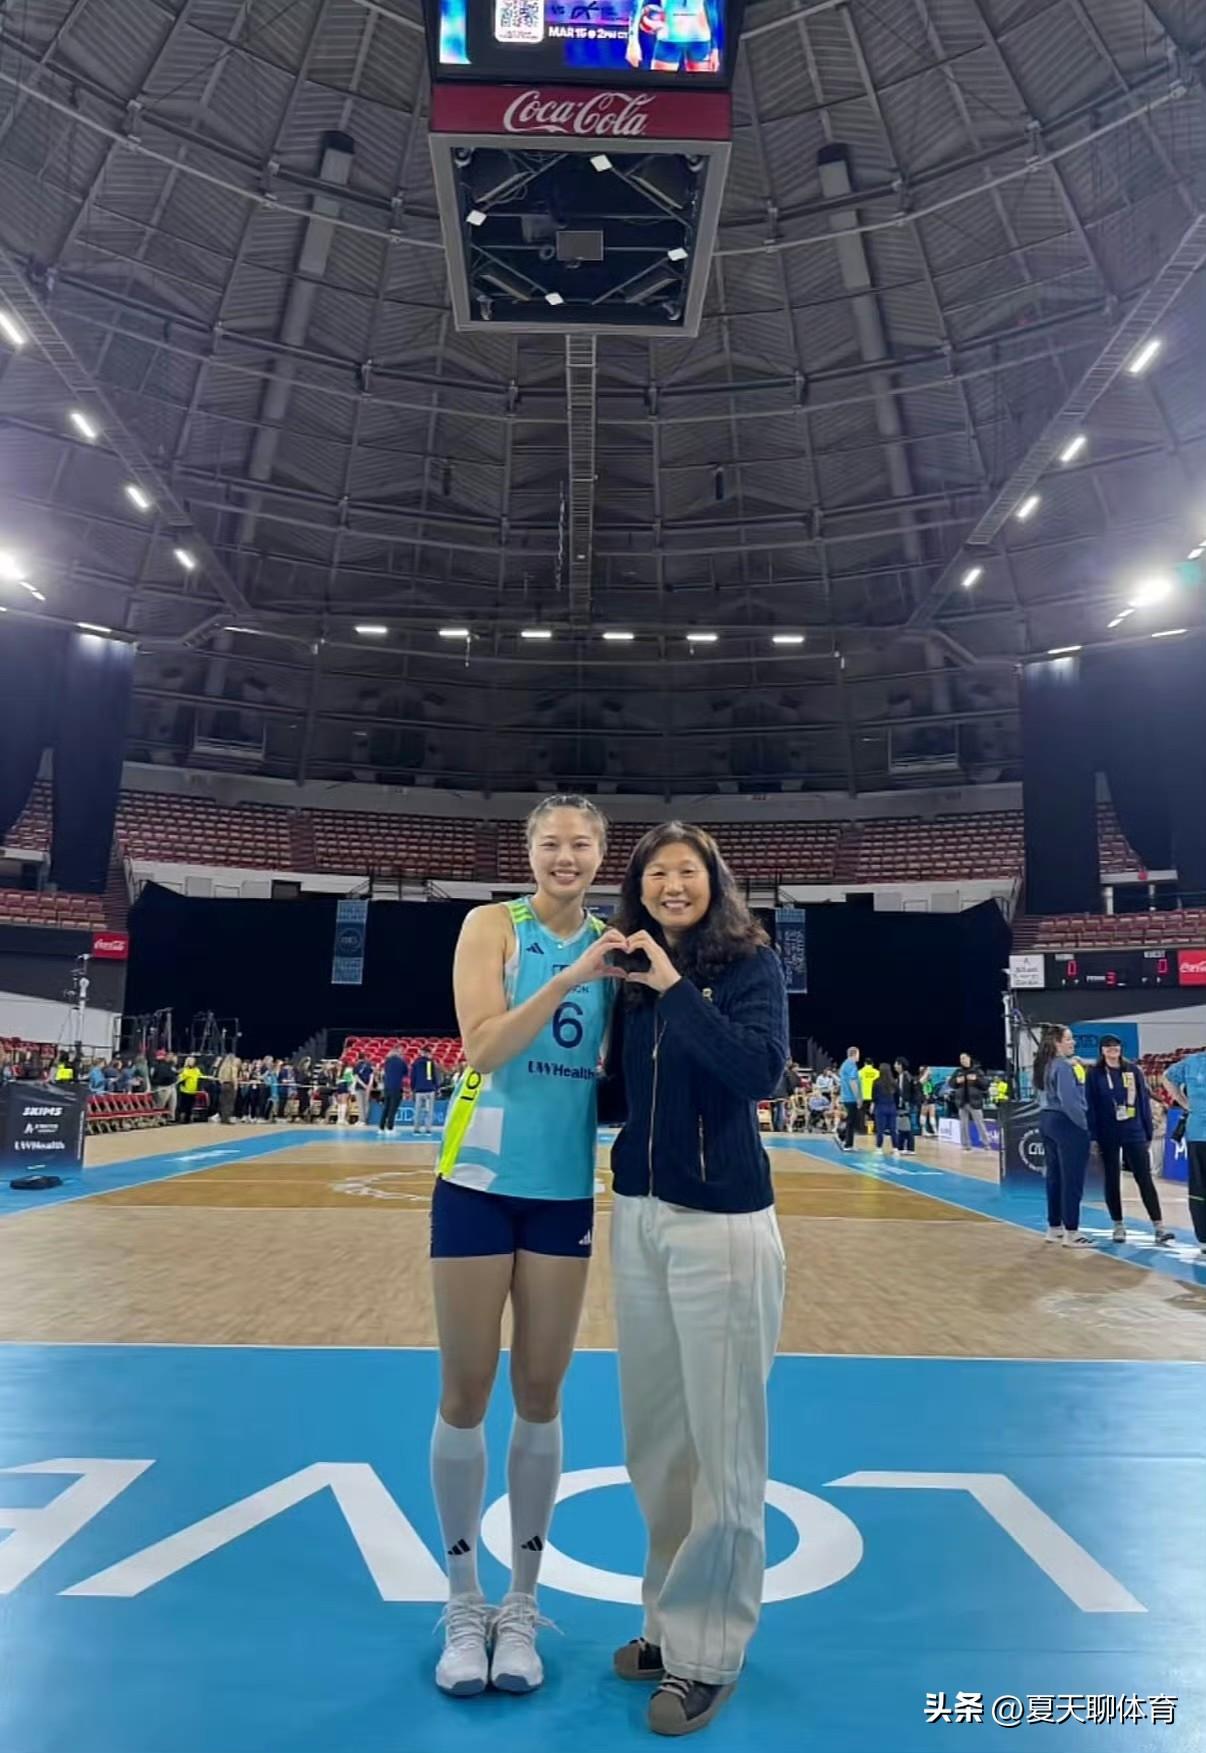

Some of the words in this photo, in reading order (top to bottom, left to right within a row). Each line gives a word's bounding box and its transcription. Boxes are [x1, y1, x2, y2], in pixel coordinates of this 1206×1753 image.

[548, 25, 574, 38] MAR
[503, 89, 656, 136] Coca-Cola
[551, 1001, 585, 1049] 6
